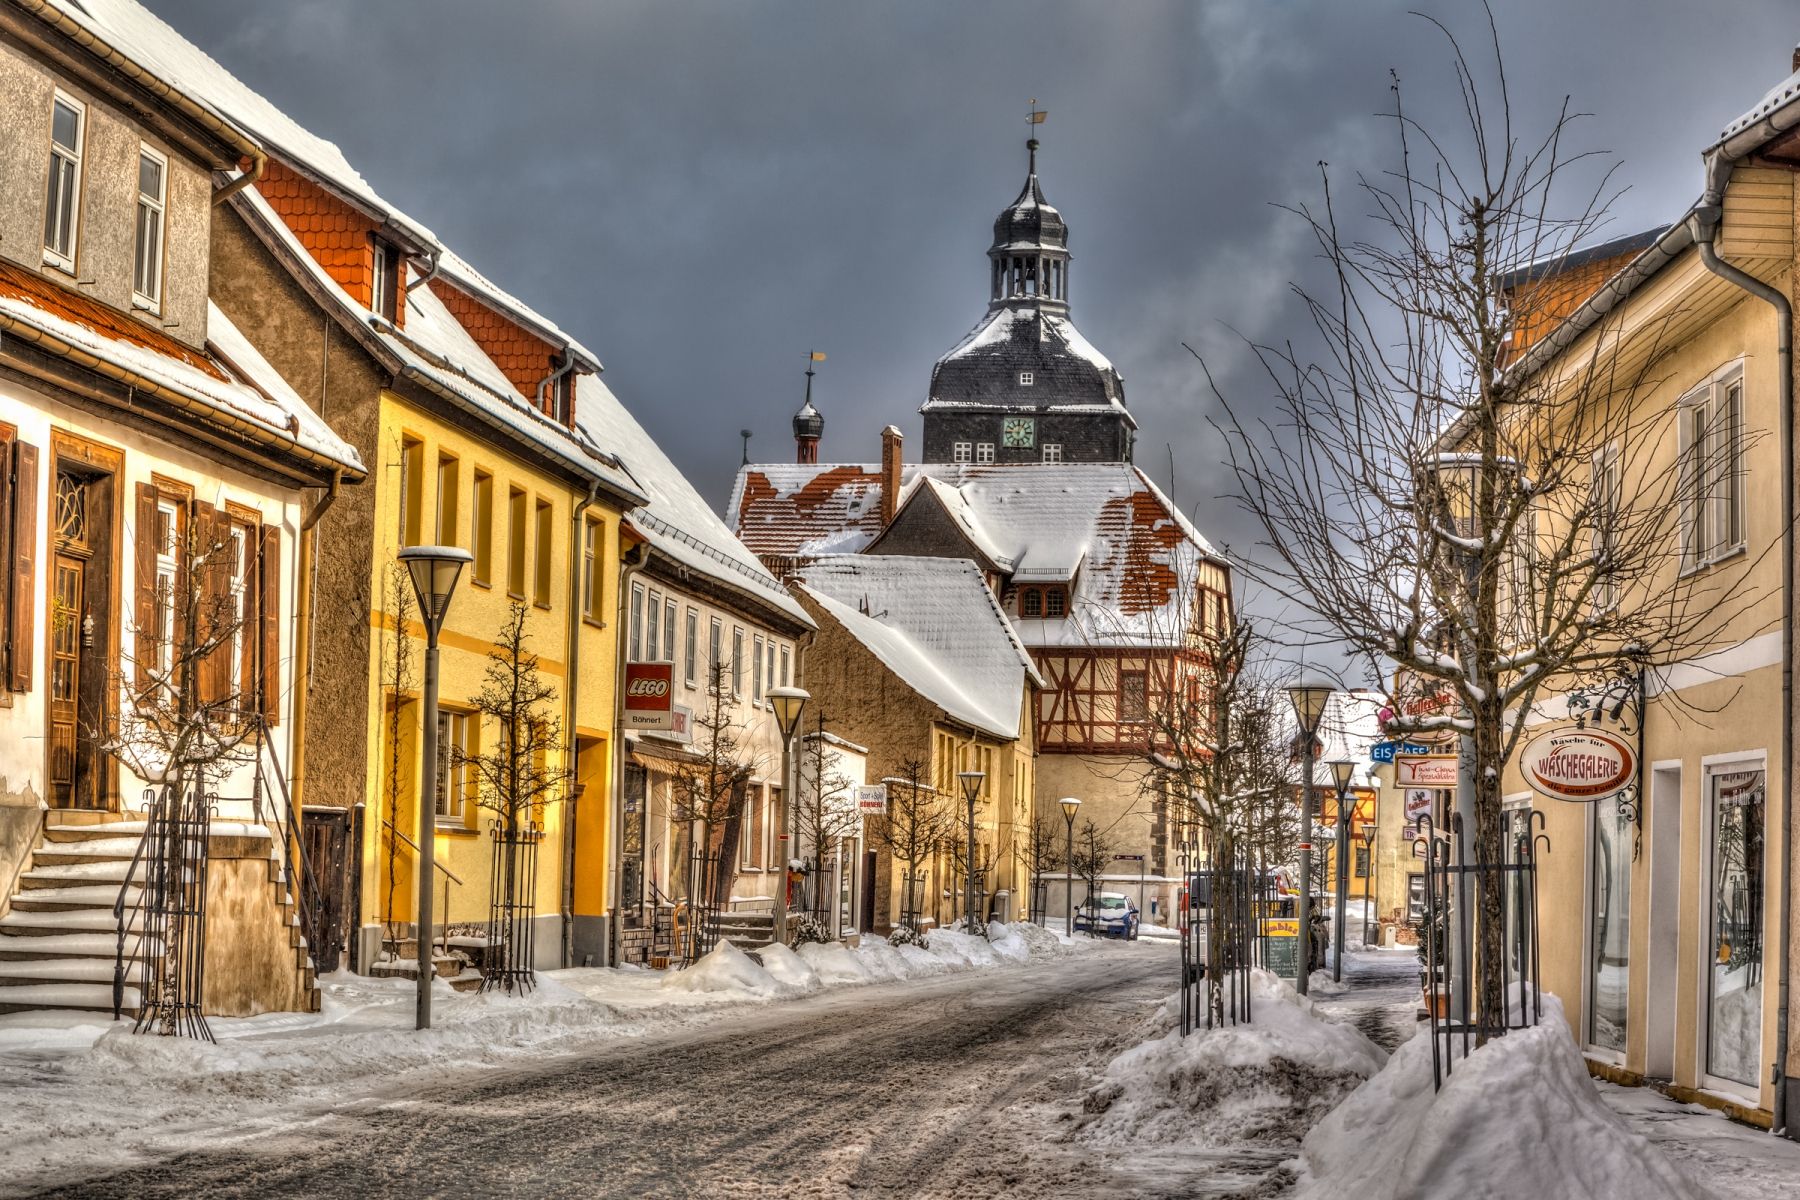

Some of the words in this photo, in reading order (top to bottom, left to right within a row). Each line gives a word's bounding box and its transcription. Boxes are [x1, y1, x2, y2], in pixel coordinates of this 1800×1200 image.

[628, 678, 669, 697] LEGO
[632, 715, 661, 724] Böhnert
[1550, 737, 1586, 747] Wäsche
[1590, 738, 1606, 748] für
[1374, 747, 1392, 759] EIS
[1538, 753, 1619, 780] WÄSCHEGALERIE
[1547, 782, 1562, 791] die
[1594, 775, 1626, 793] Familie
